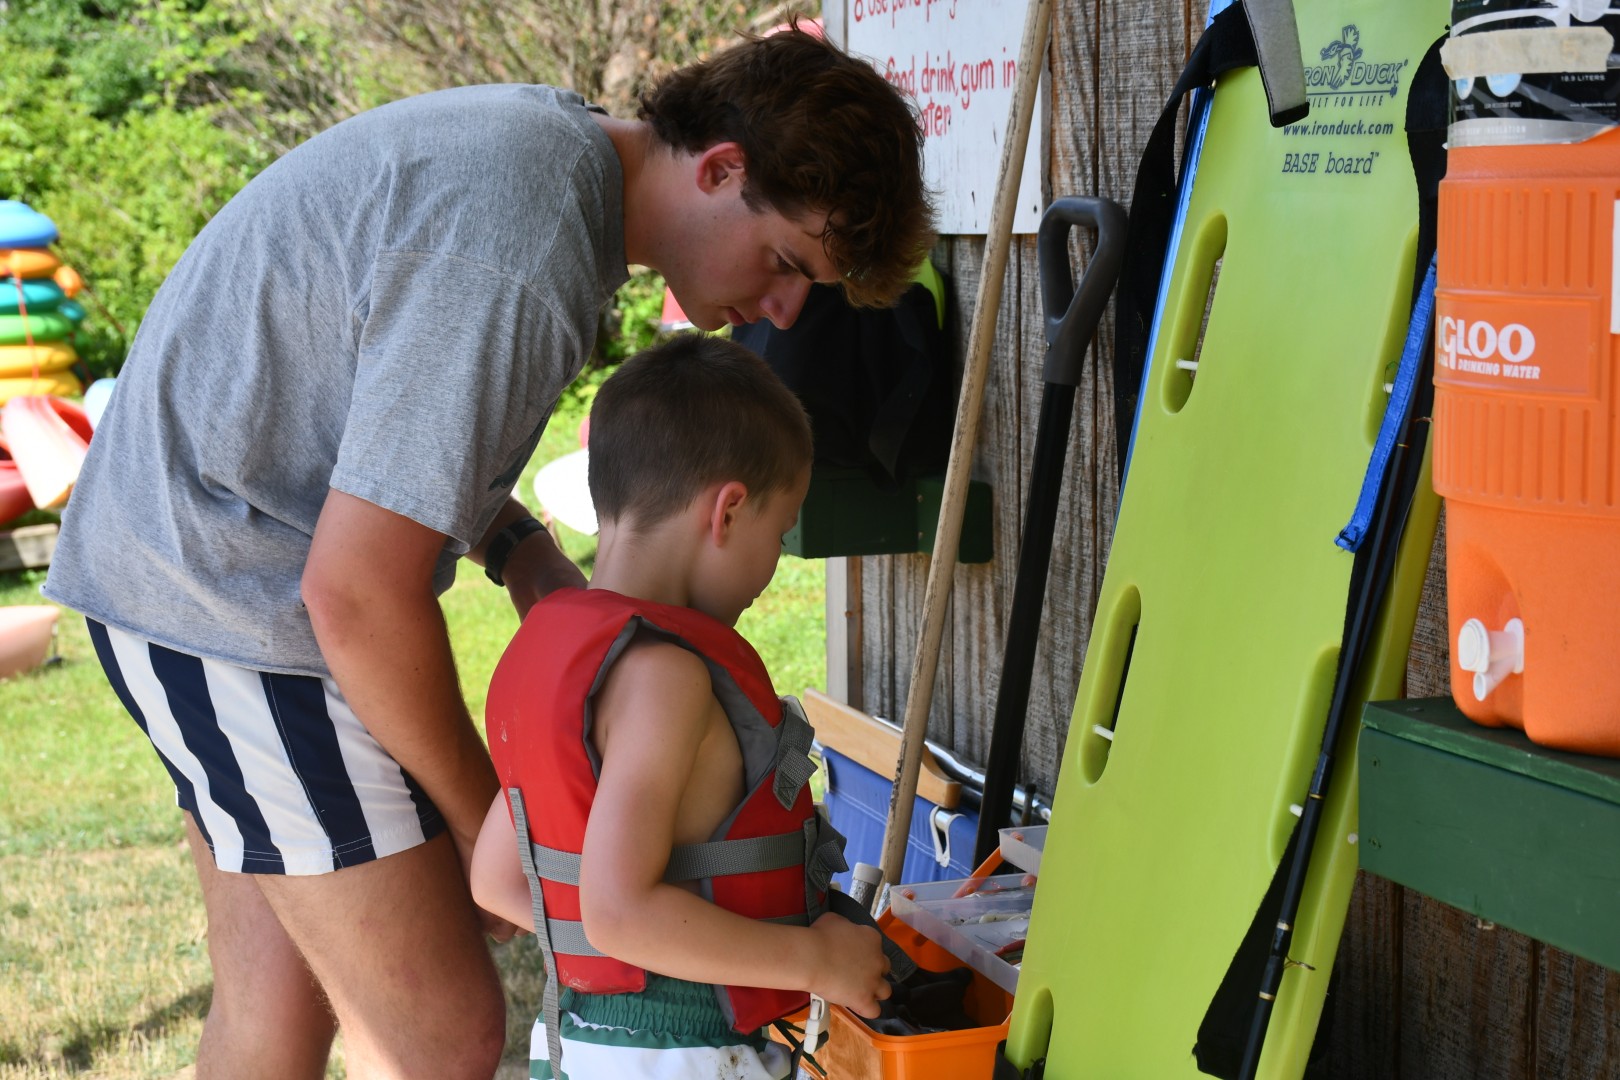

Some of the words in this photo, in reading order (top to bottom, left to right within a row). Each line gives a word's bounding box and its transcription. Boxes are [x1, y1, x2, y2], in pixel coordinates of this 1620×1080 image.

[921, 51, 959, 97] drink,
[961, 58, 994, 110] gum
[1304, 66, 1336, 87] RON
[1577, 74, 1605, 82] LITERS
[1334, 96, 1354, 107] FOR
[1359, 95, 1384, 107] LIFE
[1283, 120, 1394, 136] www.ironduck.com
[1282, 153, 1320, 173] BASE
[1438, 315, 1536, 370] IGLOO
[1458, 358, 1500, 376] DRINKING
[1502, 363, 1541, 380] WATER
